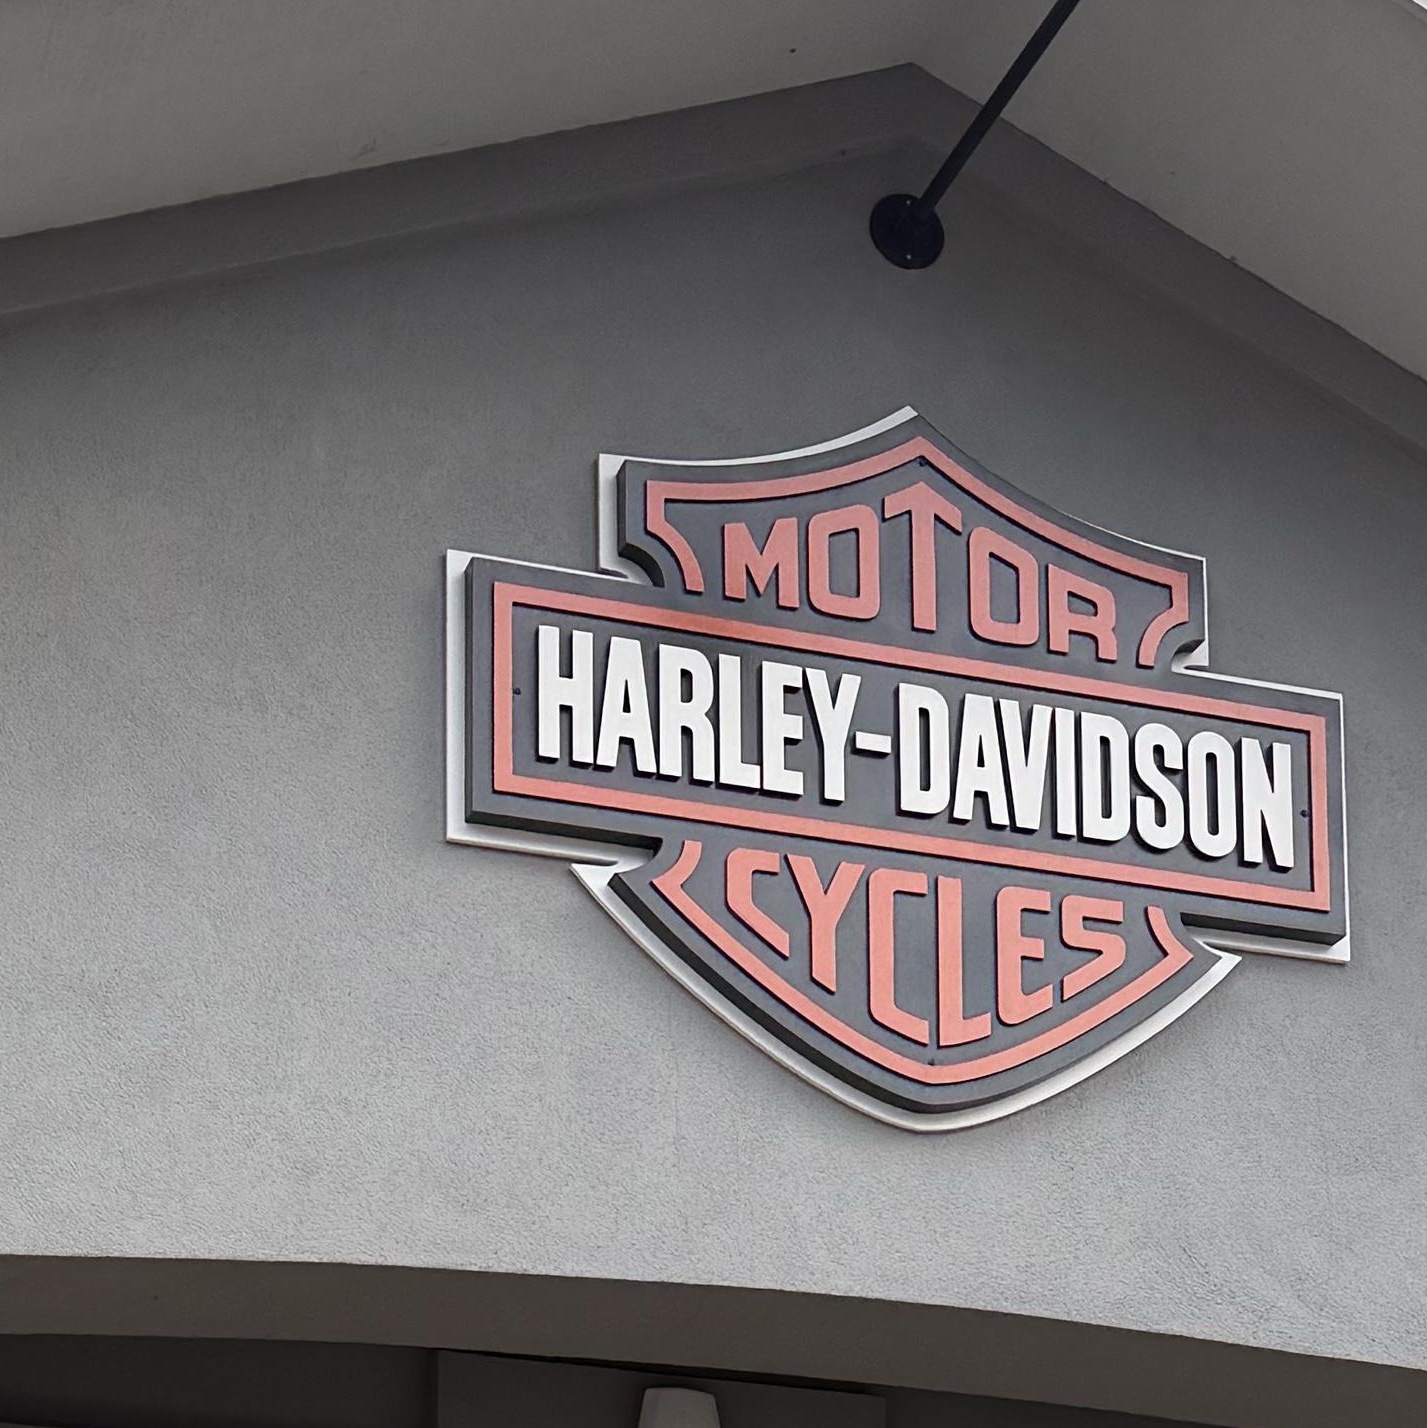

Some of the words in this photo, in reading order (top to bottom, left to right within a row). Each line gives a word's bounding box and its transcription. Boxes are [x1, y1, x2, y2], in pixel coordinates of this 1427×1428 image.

[725, 481, 1118, 663] MOTOR
[538, 625, 1294, 869] HARLEY-DAVIDSON
[726, 848, 1127, 1047] CYCLES
